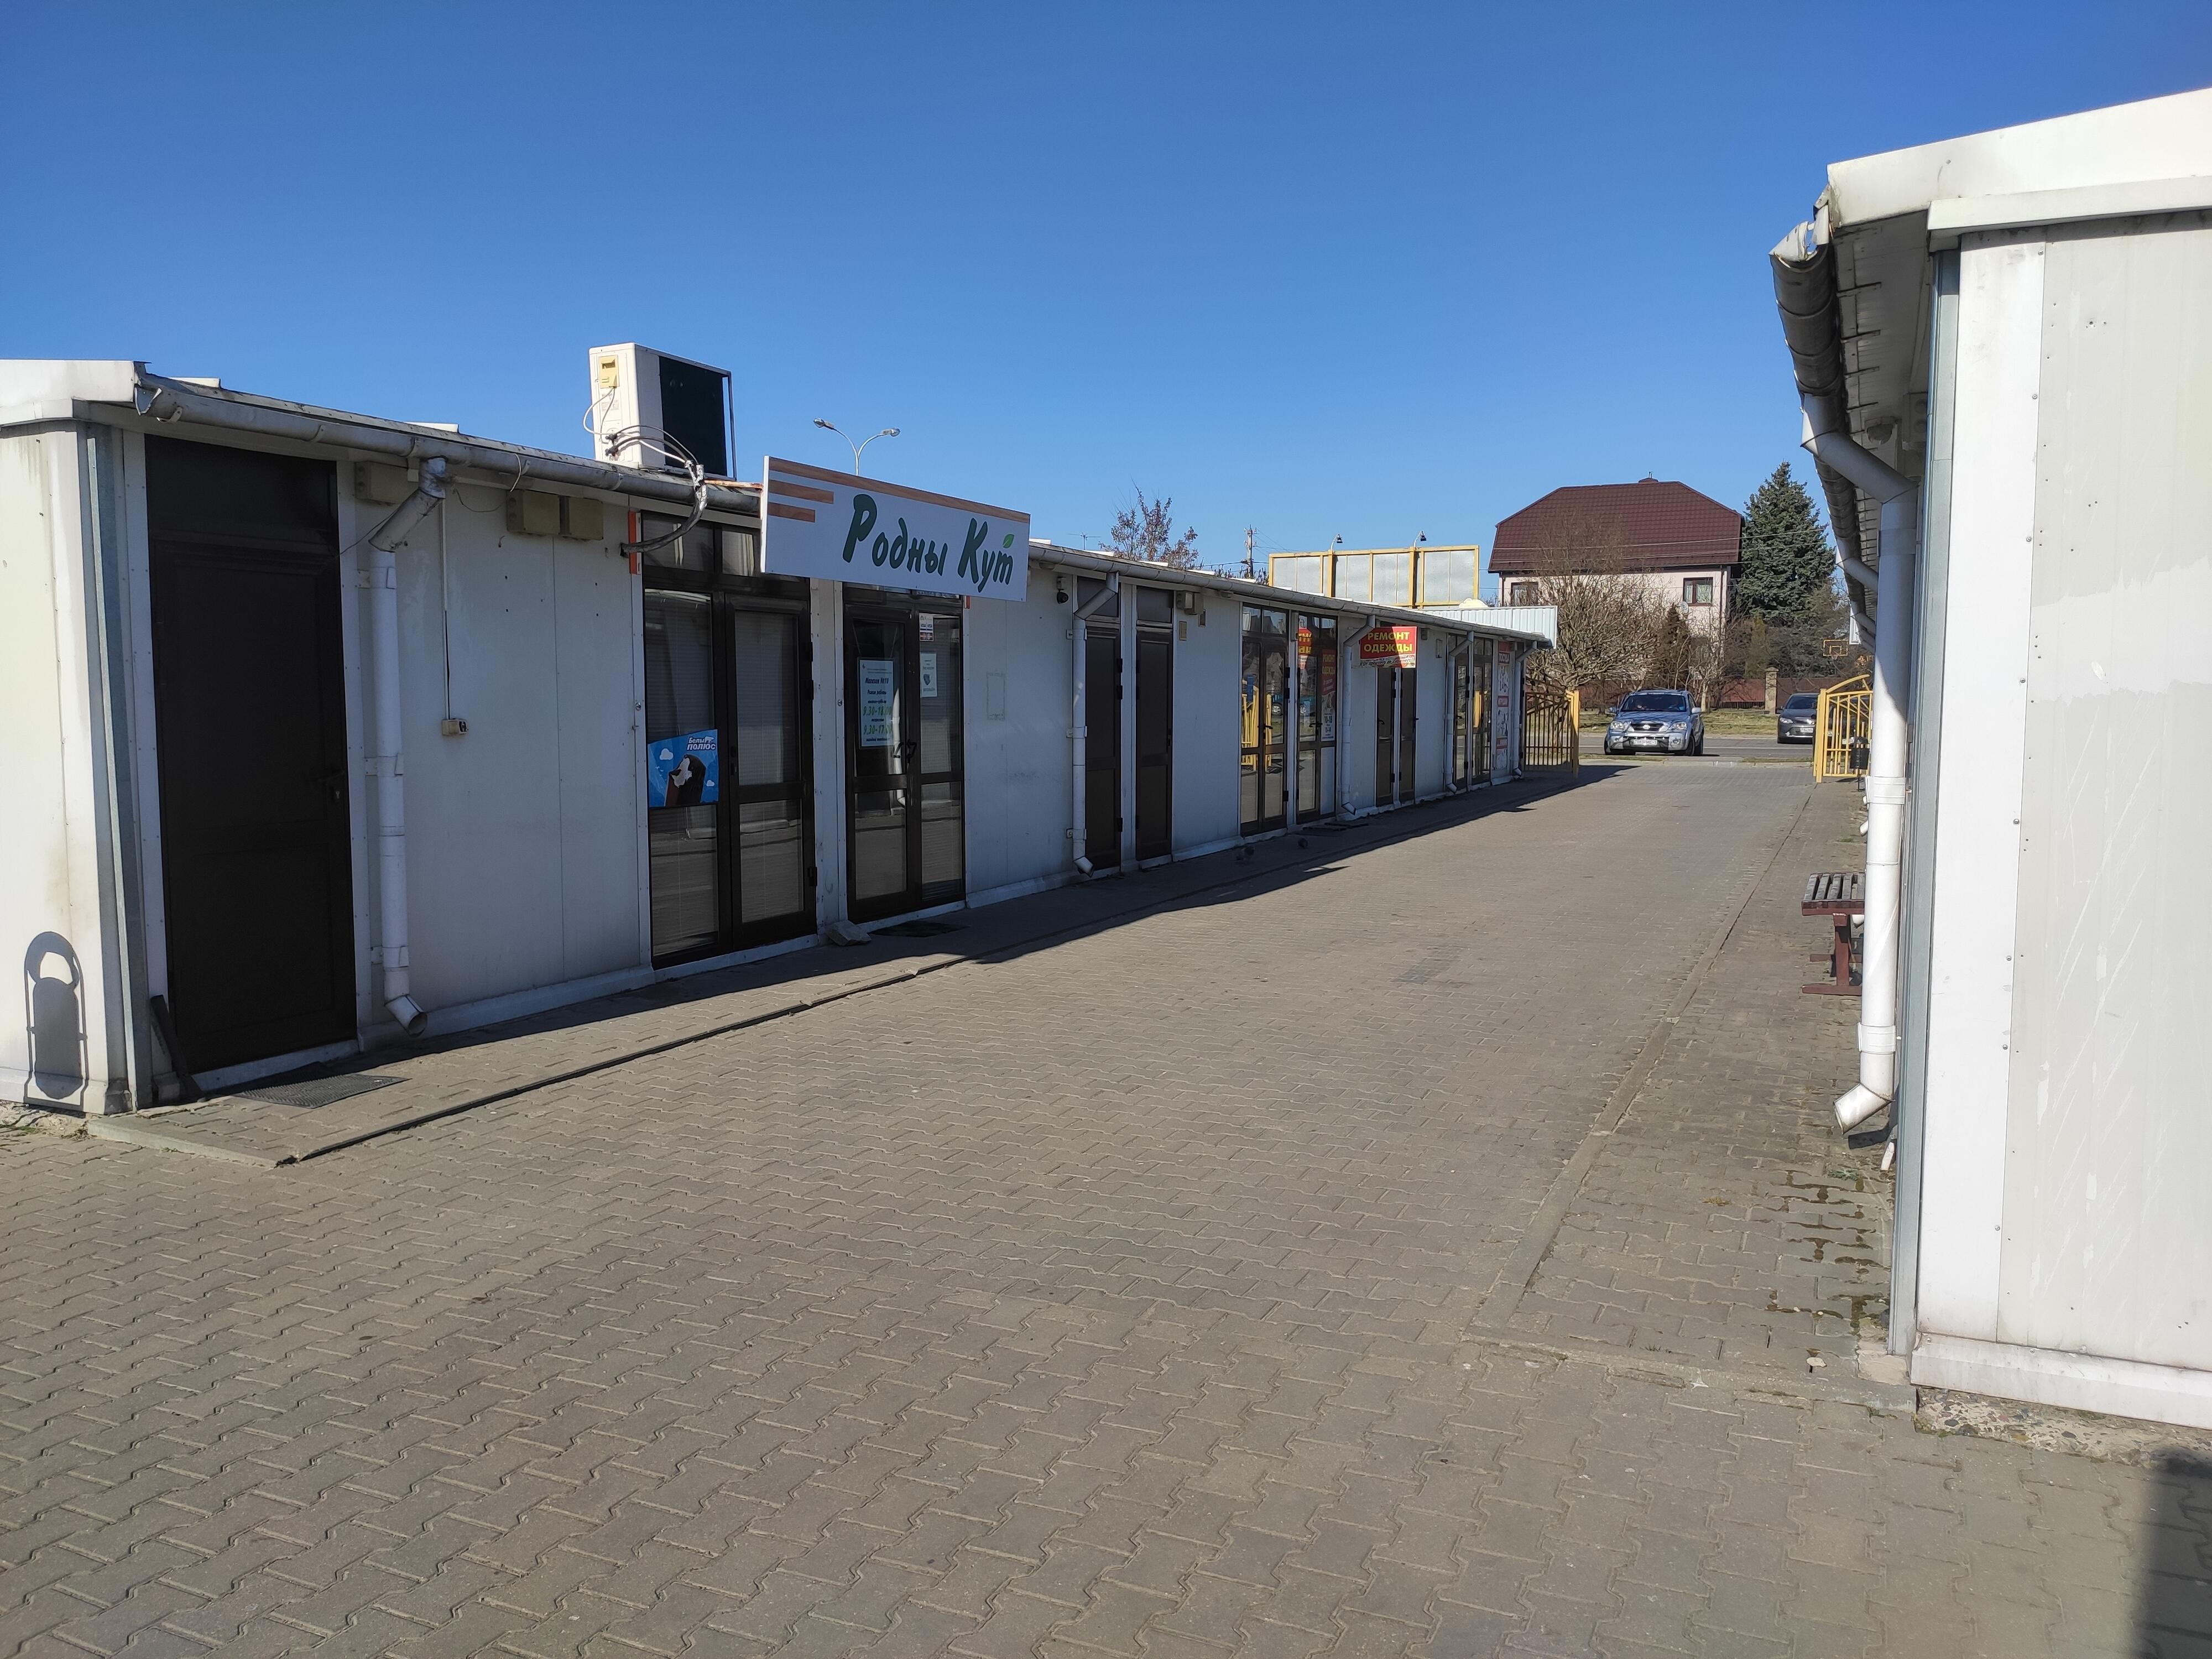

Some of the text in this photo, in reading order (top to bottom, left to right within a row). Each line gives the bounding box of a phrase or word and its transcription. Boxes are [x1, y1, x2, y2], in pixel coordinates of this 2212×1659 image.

[842, 494, 1013, 593] Родны Кут
[1368, 632, 1410, 640] РЕМОНТ
[1364, 643, 1413, 653] ОДЕЖДЫ
